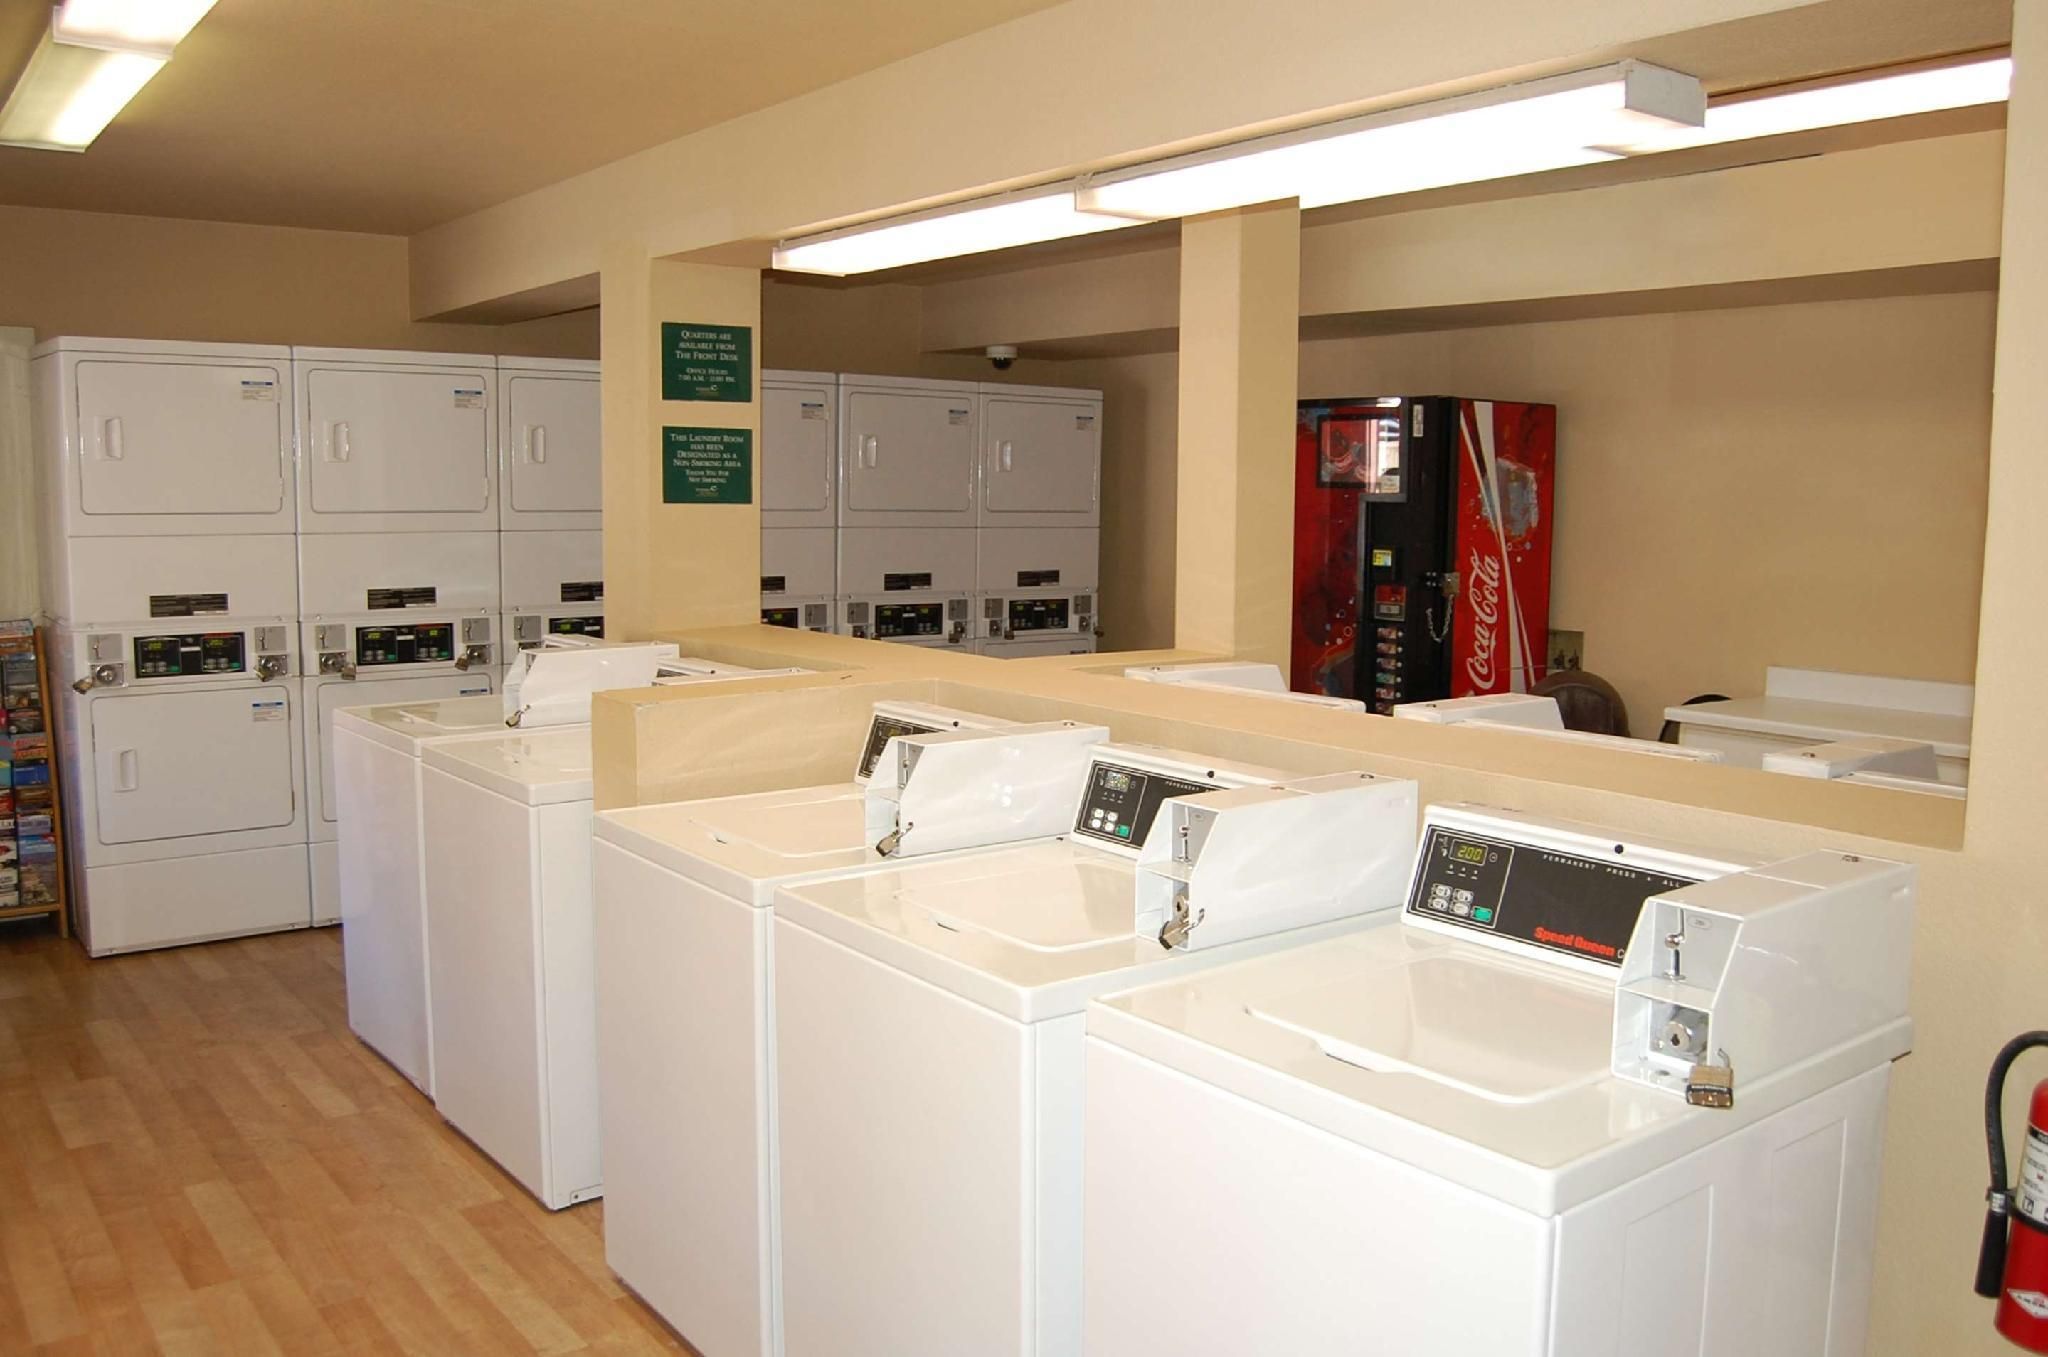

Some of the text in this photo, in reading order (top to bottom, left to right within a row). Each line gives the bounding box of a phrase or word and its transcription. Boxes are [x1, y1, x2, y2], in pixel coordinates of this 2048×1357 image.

[675, 350, 691, 359] THE
[693, 351, 717, 360] FRONT
[723, 435, 744, 443] ROOM
[1466, 547, 1500, 690] Coca-Cola
[1457, 845, 1483, 861] 200
[1542, 854, 1596, 871] PERMANENT
[1606, 867, 1636, 879] PRESS
[1534, 926, 1574, 946] Speed
[1575, 936, 1616, 958] Queen
